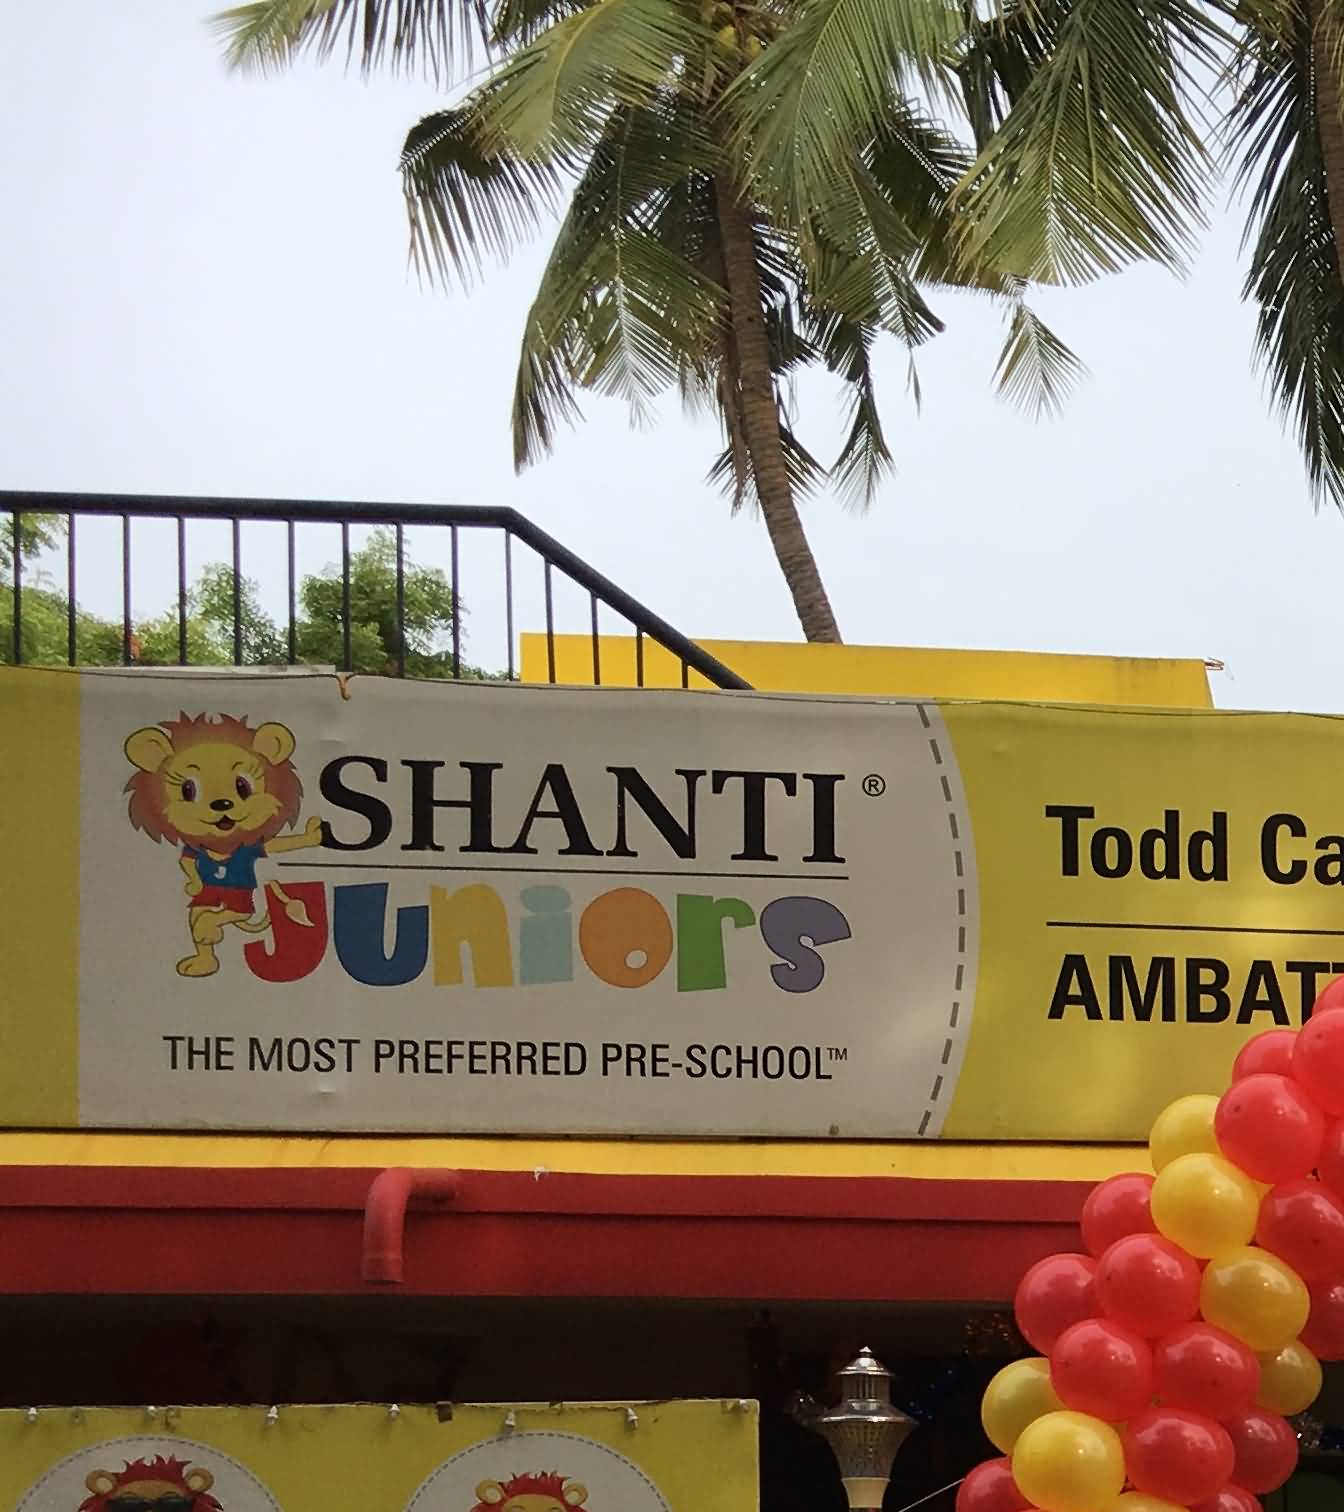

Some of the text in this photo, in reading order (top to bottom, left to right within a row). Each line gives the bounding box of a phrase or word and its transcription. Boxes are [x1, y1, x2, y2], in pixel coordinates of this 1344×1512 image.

[318, 755, 847, 864] SHANTI
[1045, 805, 1230, 883] Todd
[163, 1034, 234, 1073] THE
[247, 1036, 361, 1075] MOST
[374, 1039, 587, 1077] PREFERRED
